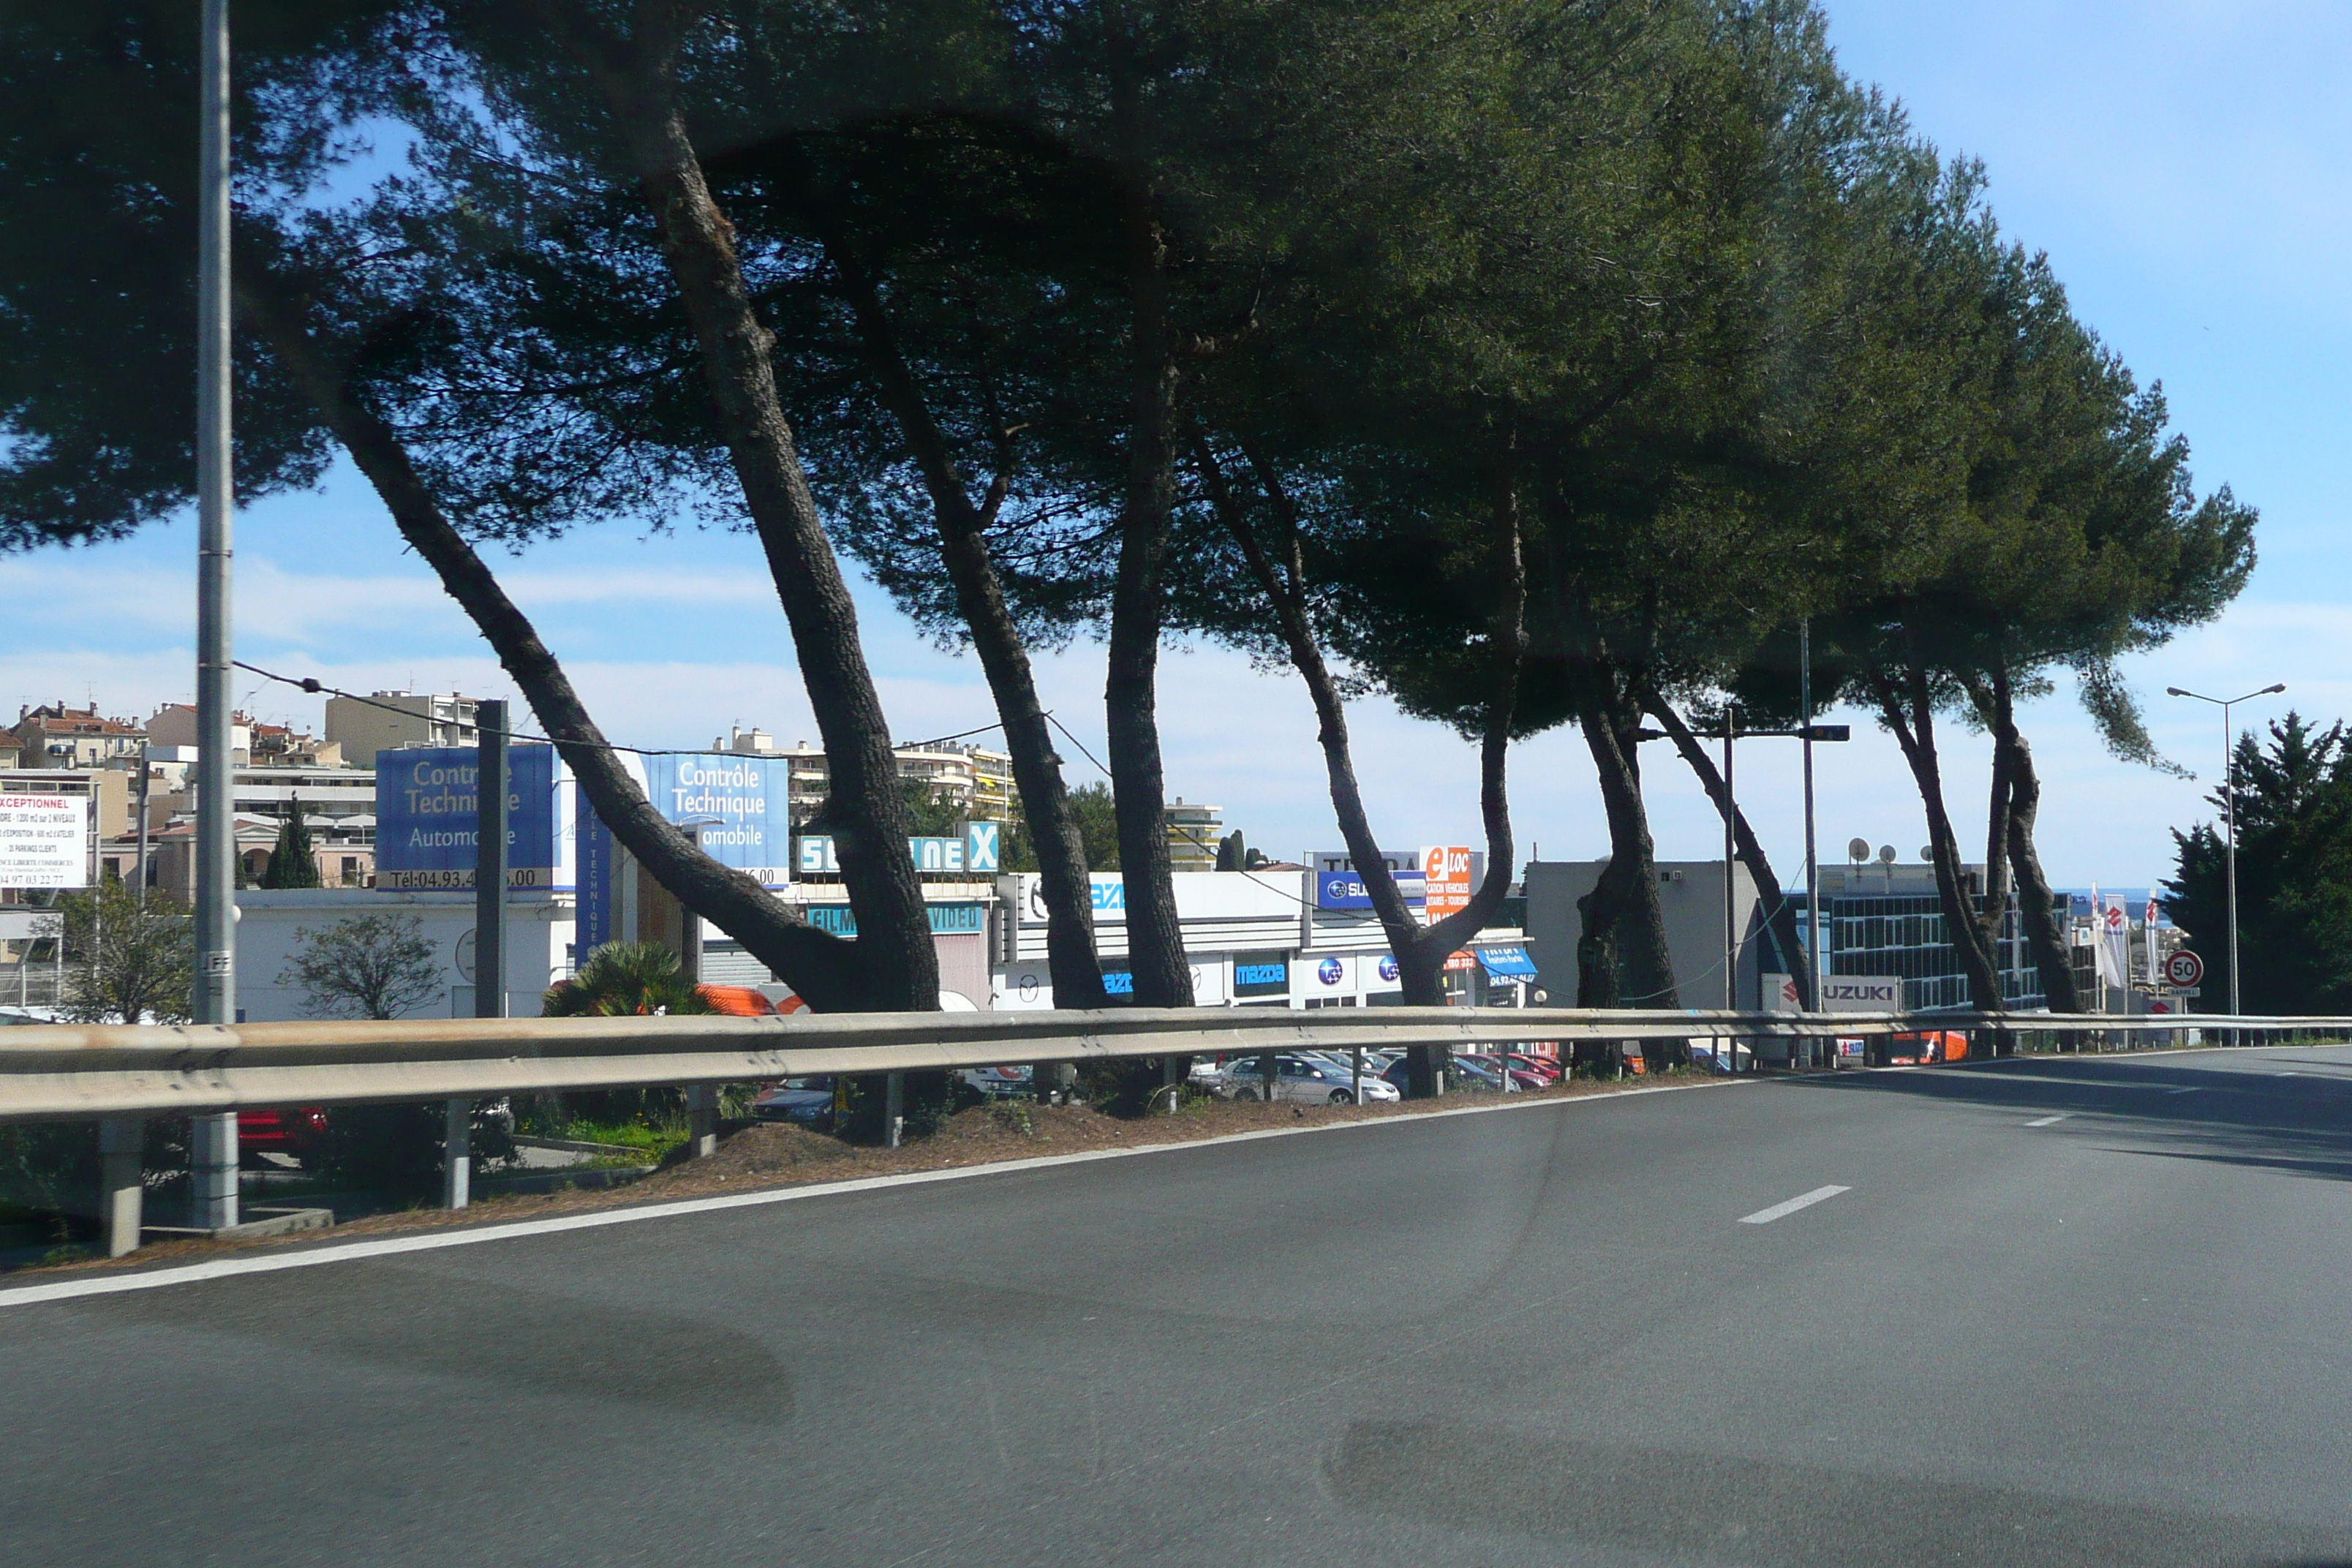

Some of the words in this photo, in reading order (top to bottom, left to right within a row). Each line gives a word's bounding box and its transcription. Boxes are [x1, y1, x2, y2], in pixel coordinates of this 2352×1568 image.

[413, 761, 512, 786] Contr
[679, 762, 759, 788] Contrôle
[0, 798, 69, 809] XCEPTIONNEL
[404, 785, 520, 814] Technie
[672, 787, 765, 822] Technique
[409, 827, 516, 848] Automoe
[702, 824, 762, 845] omobile
[39, 845, 57, 853] CLIENTS
[1449, 853, 1469, 873] LOC
[12, 875, 23, 886] 97
[26, 875, 37, 886] 03
[40, 875, 50, 886] 22
[53, 875, 64, 886] 77
[589, 849, 598, 942] TECHNIQUE
[932, 906, 977, 929] VIDEO
[1236, 964, 1285, 985] mazda
[2173, 962, 2193, 976] 50
[1823, 985, 1893, 1000] UZUKI
